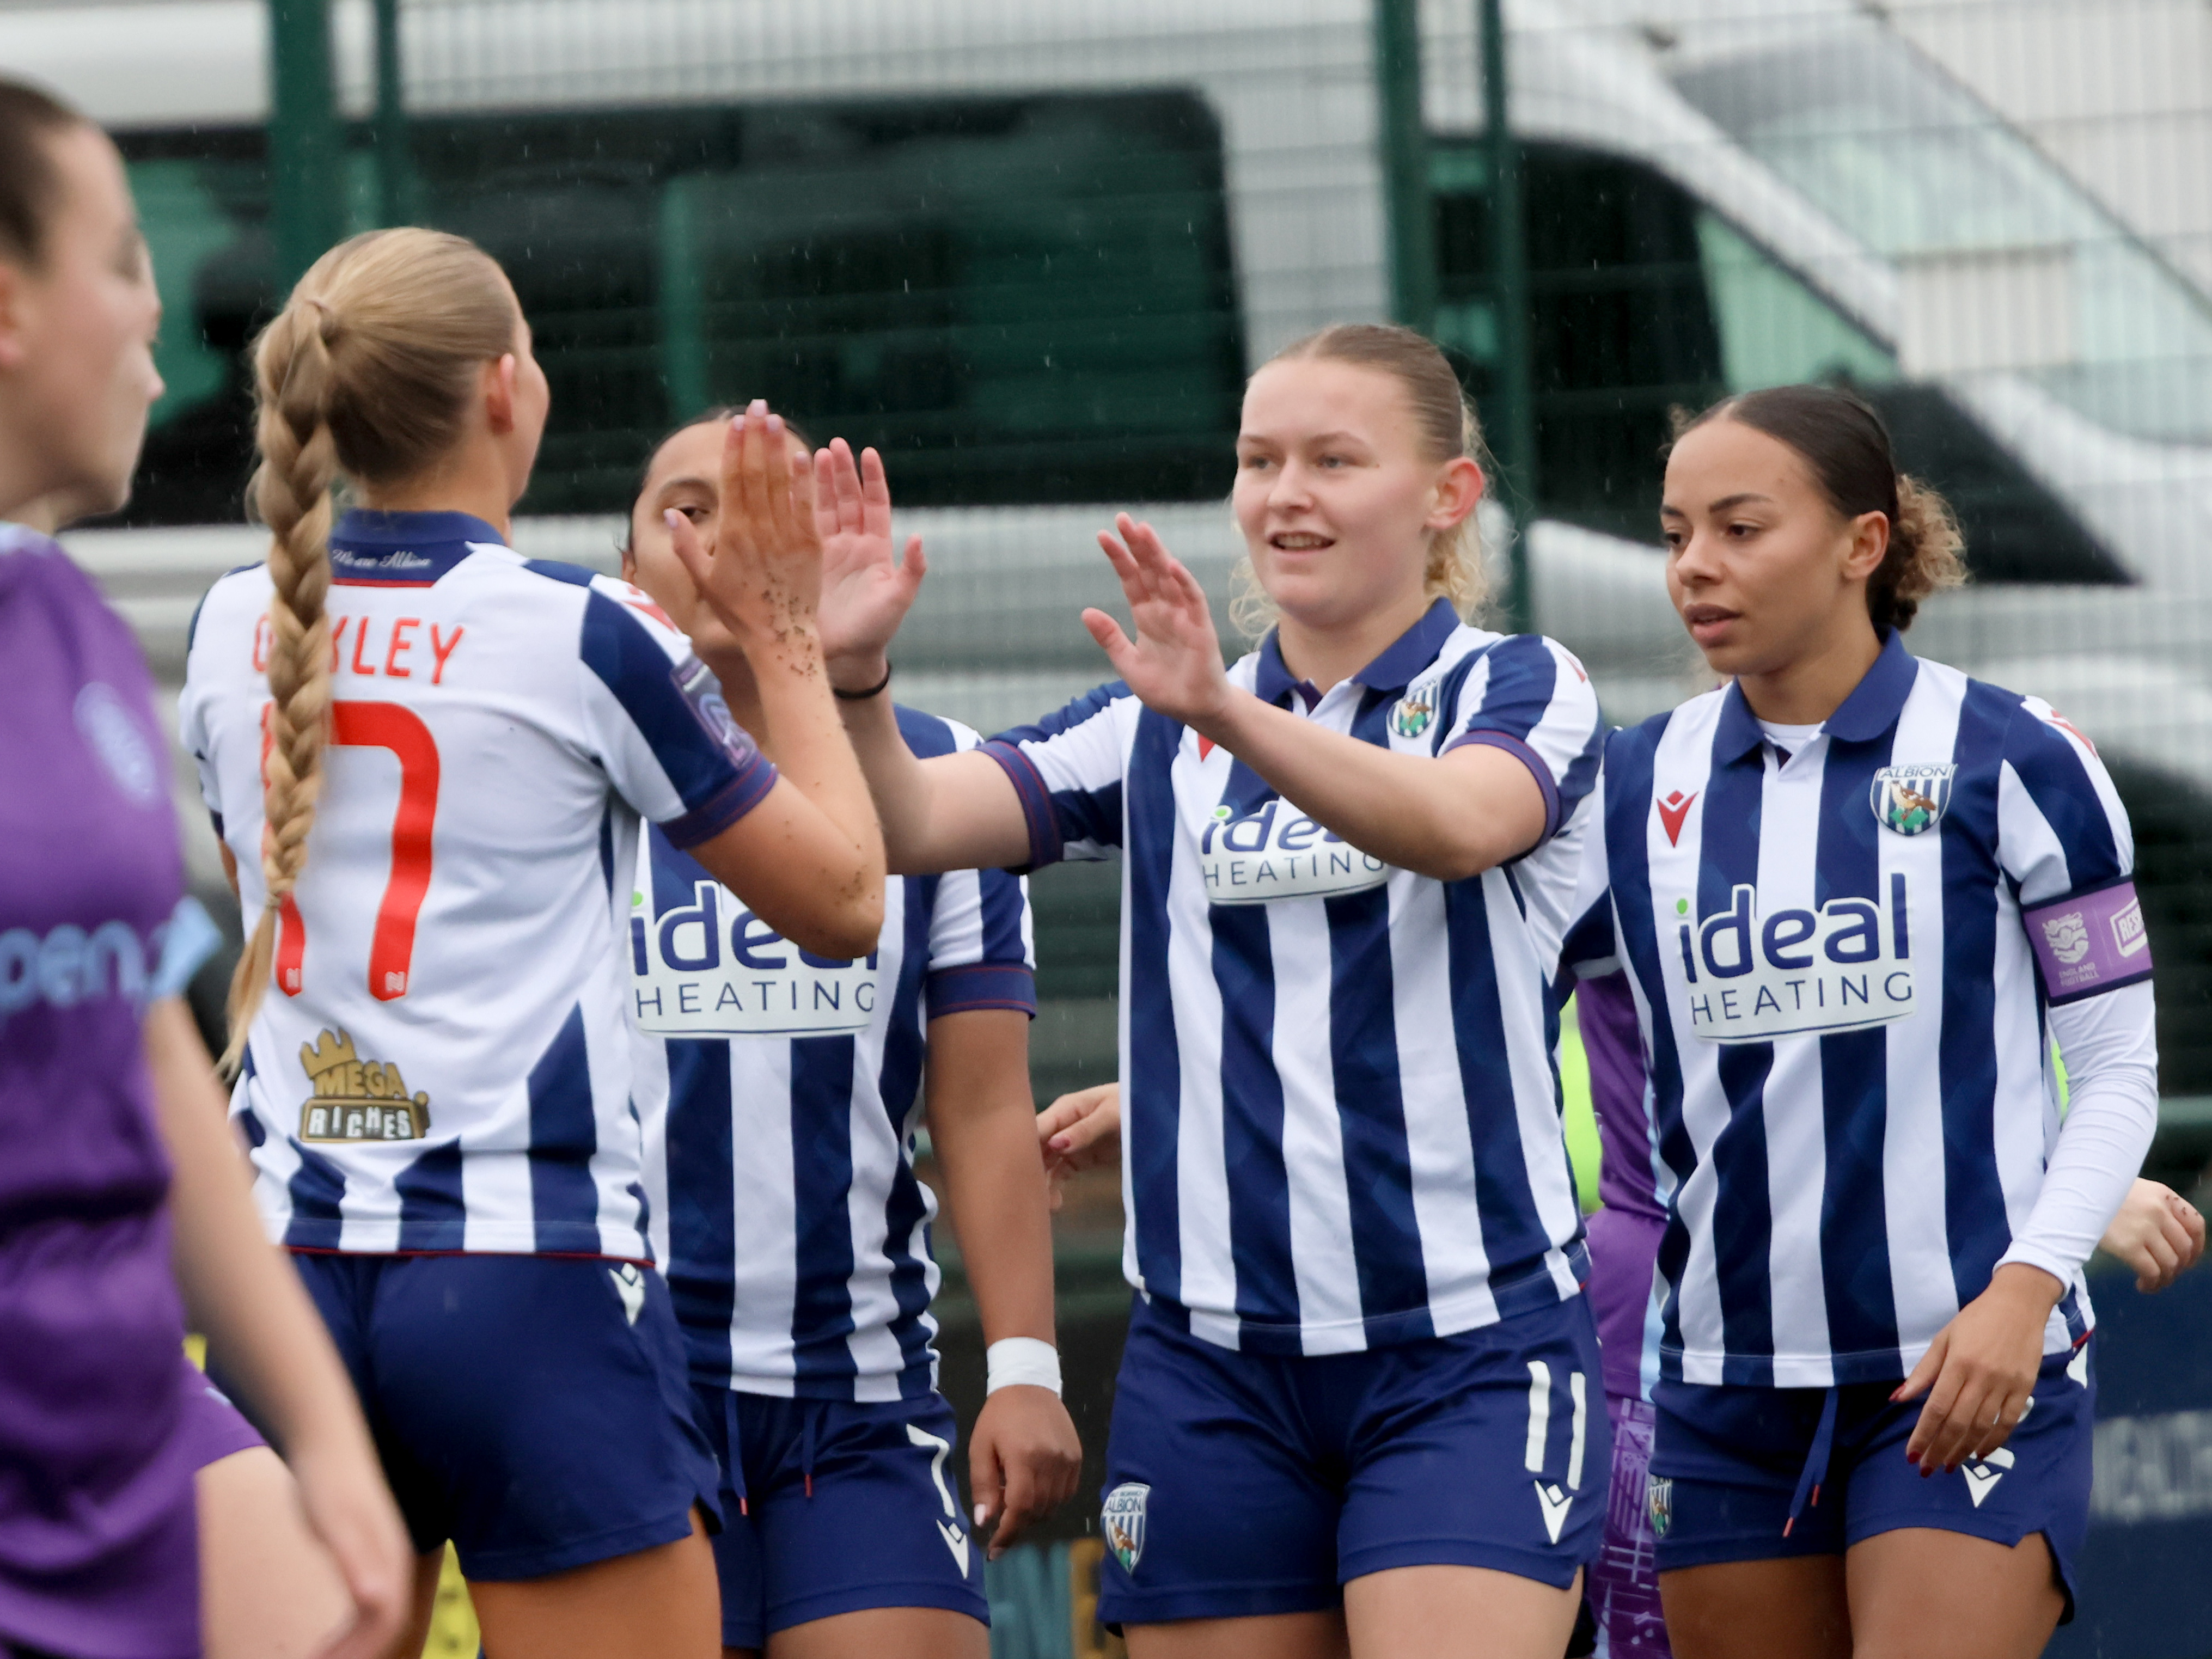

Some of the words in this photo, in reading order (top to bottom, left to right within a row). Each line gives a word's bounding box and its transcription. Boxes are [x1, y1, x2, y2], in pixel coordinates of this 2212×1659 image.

[252, 612, 465, 685] OKLEY
[1880, 767, 1948, 779] ALBION
[1201, 801, 1347, 855] ide
[630, 883, 878, 976] ide
[1676, 872, 1910, 984] ideal
[636, 980, 875, 1018] HEATING
[1690, 971, 1912, 1025] HEATING
[314, 1060, 407, 1099] MEGA
[308, 1105, 412, 1140] RICHES
[1525, 1360, 1587, 1491] 11
[906, 1423, 956, 1518] 7
[1104, 1497, 1142, 1513] ALBION
